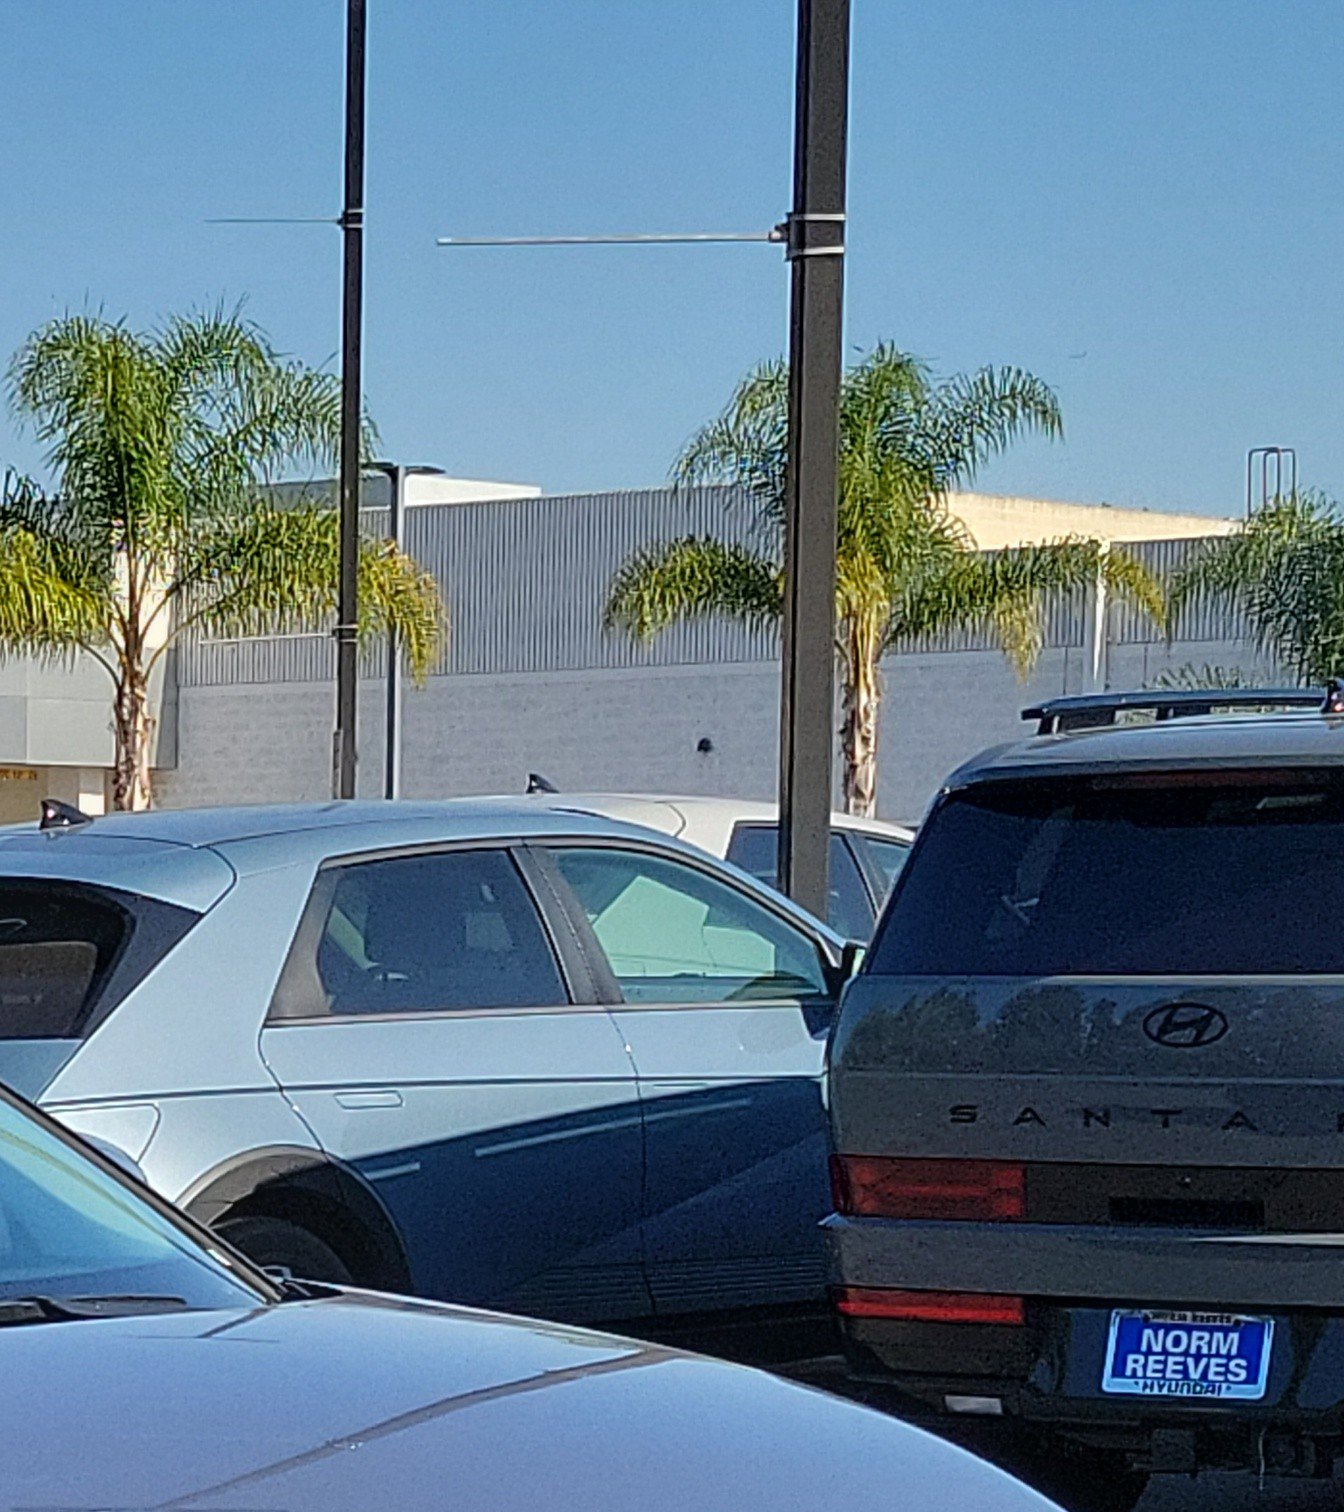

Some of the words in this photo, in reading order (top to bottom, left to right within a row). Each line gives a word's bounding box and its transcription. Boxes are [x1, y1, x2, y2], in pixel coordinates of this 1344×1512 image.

[949, 1103, 1258, 1132] SANTA
[1140, 1328, 1240, 1356] NORM
[1124, 1353, 1249, 1383] REEVES
[1141, 1379, 1223, 1397] HYUNDAI
